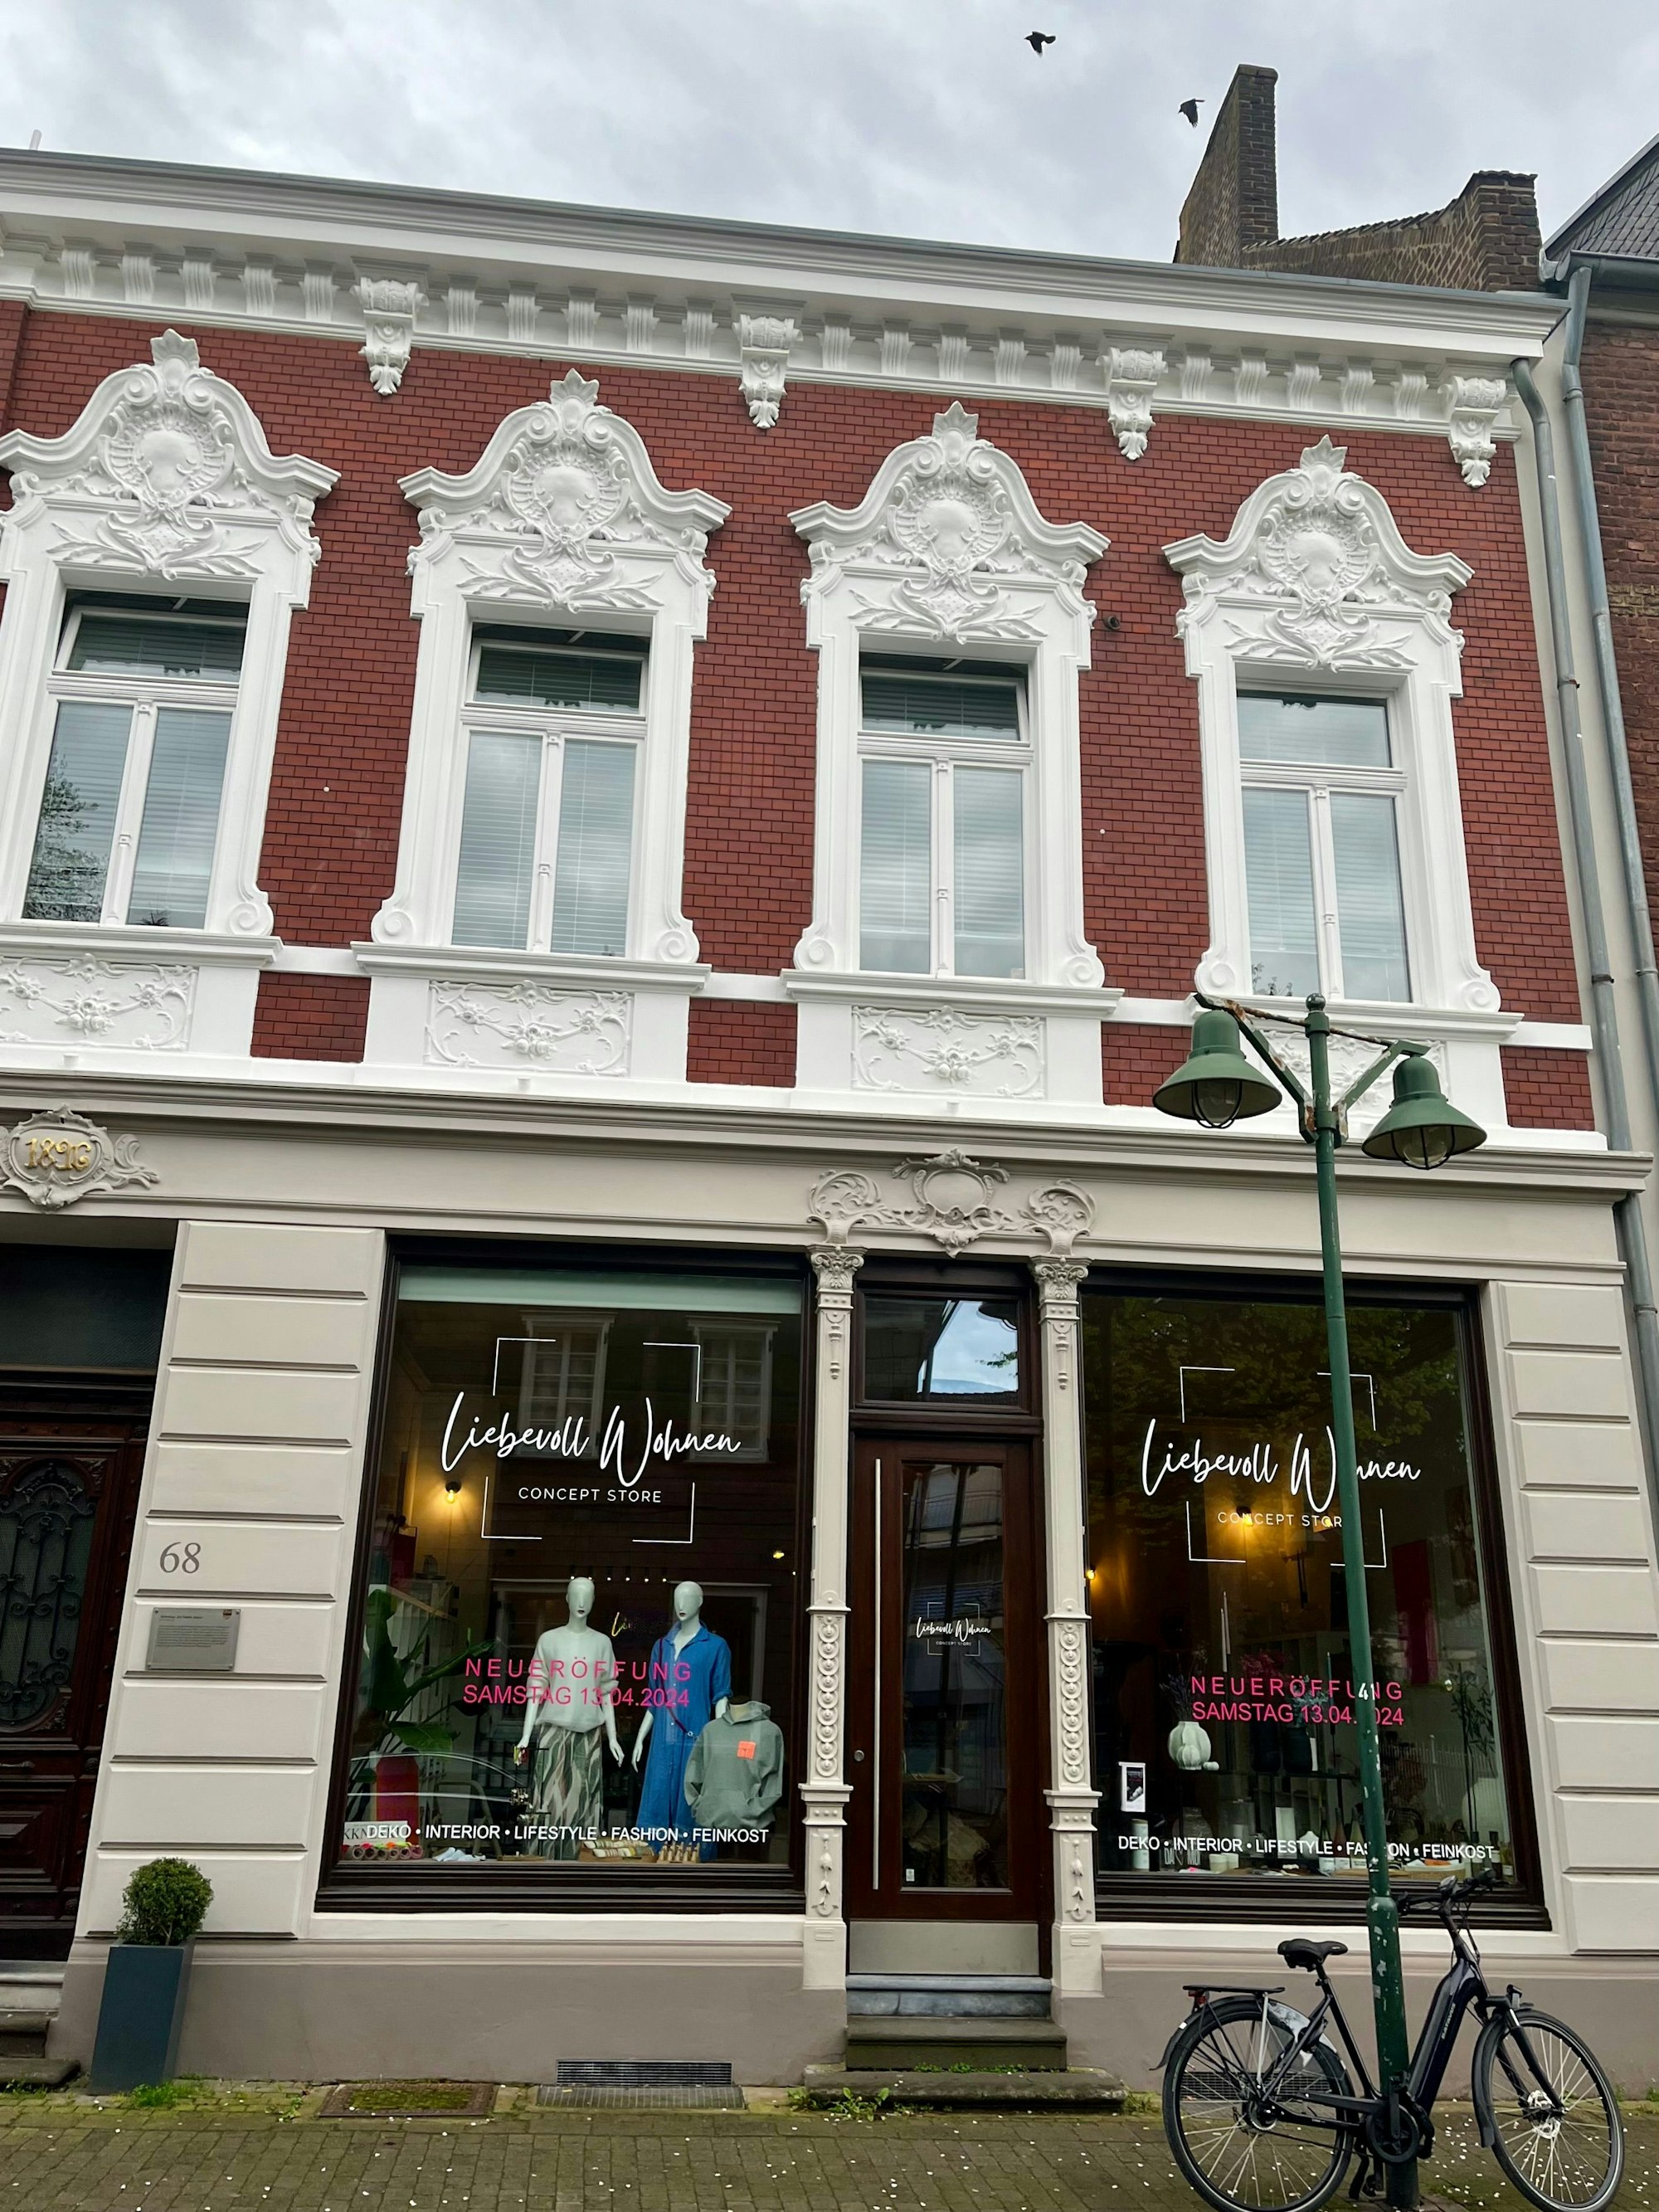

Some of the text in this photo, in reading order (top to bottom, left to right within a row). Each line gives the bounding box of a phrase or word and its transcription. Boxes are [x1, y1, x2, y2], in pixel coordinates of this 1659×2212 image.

[24, 1138, 91, 1172] 1896
[441, 1391, 742, 1488] Liebevoll Wohnen
[1142, 1418, 1421, 1513] Liebevoll Wnen
[518, 1487, 662, 1503] CONCEPT STORE
[1218, 1512, 1343, 1527] CONCEPT STOR
[160, 1542, 201, 1574] 68
[916, 1617, 991, 1642] Liebevoll Wohnen
[465, 1657, 691, 1681] NEUERÖFFUNG
[463, 1684, 689, 1708] SAMSTAG 13.04.2024
[1192, 1702, 1404, 1726] SAMSTAG 13.04.24
[367, 1825, 411, 1839] DEKO
[426, 1825, 501, 1839] INTERIOR
[514, 1825, 597, 1840] LIFESTYLE
[611, 1827, 679, 1841] FASHION
[693, 1828, 769, 1843] FEINKOST
[1118, 1835, 1160, 1850] DEKO
[1174, 1837, 1243, 1852] INTERIOR
[1255, 1839, 1334, 1854] LIFESTYLE
[1345, 1841, 1410, 1857] FAON
[1423, 1844, 1495, 1859] FEINKOST
